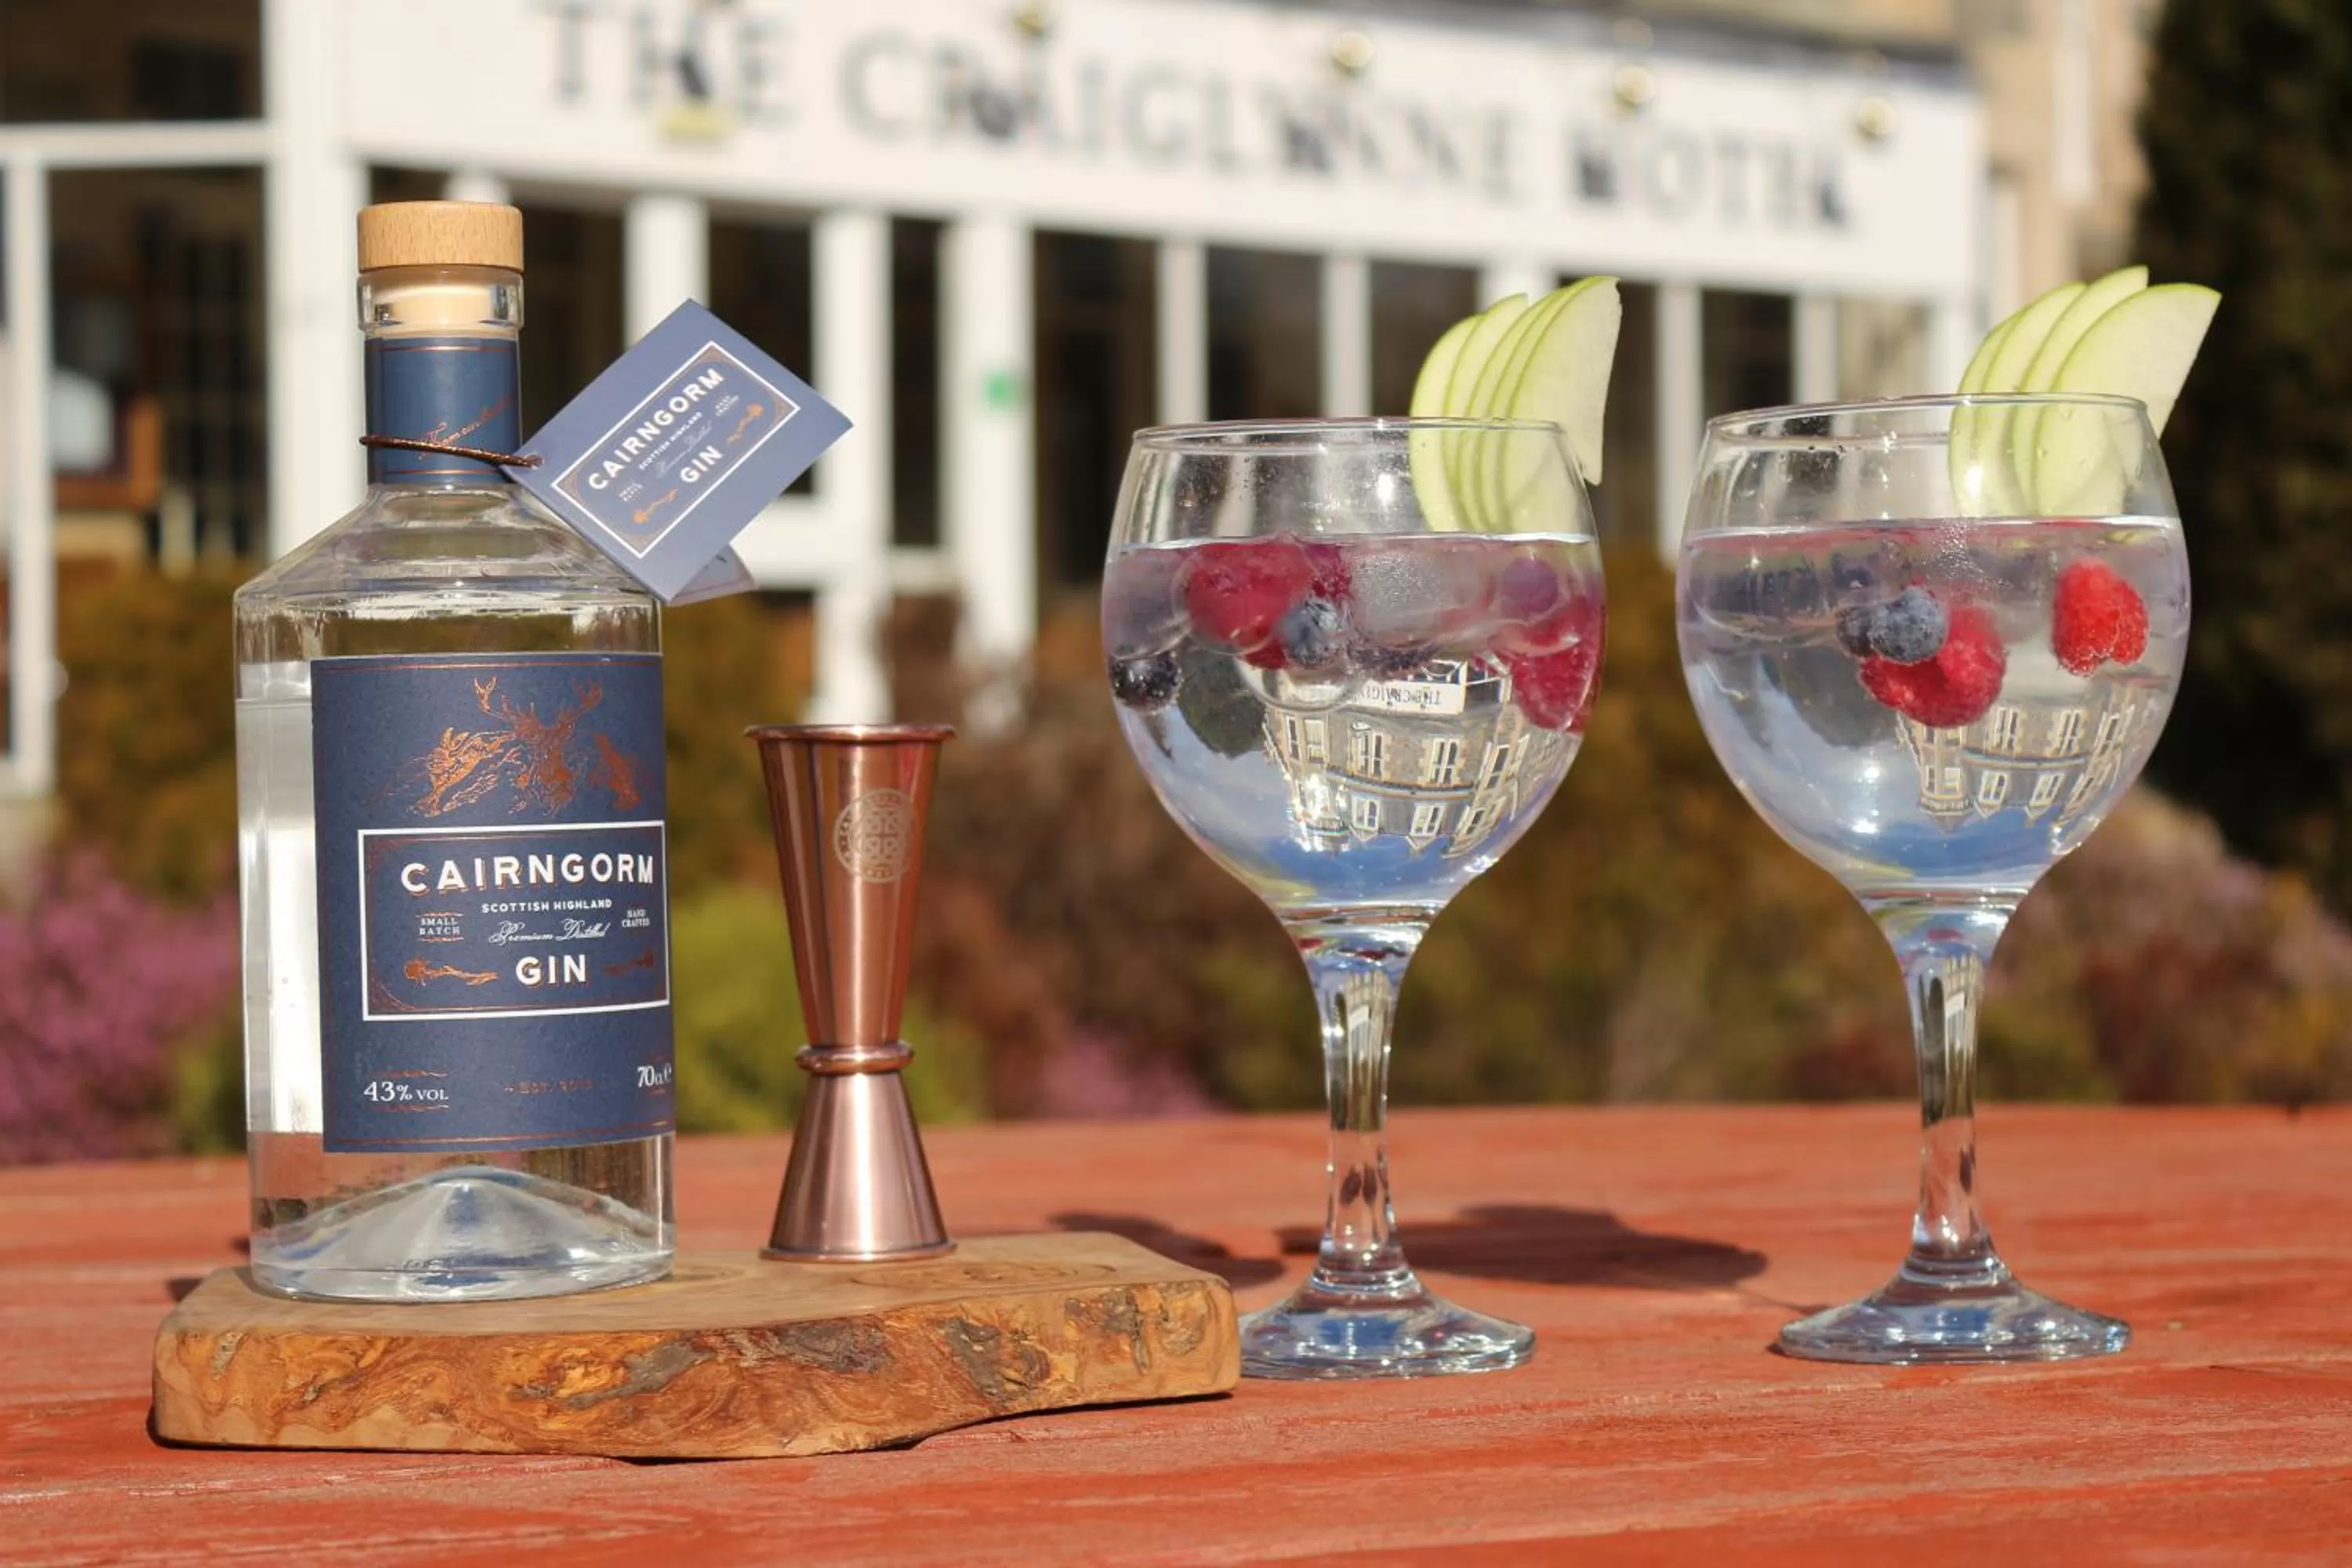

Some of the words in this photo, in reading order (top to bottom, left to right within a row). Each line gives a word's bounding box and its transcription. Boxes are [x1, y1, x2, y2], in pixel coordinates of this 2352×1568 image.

[589, 368, 724, 489] CAIRNGORM
[680, 445, 723, 483] GIN
[401, 852, 654, 893] CAIRNGORM
[481, 902, 549, 913] SCOTTISH
[554, 898, 612, 910] HIGHLAND
[419, 927, 460, 935] BATCH
[420, 917, 458, 926] SMALL
[515, 954, 587, 985] GIN
[363, 1081, 413, 1102] 43%
[416, 1089, 449, 1100] VOL
